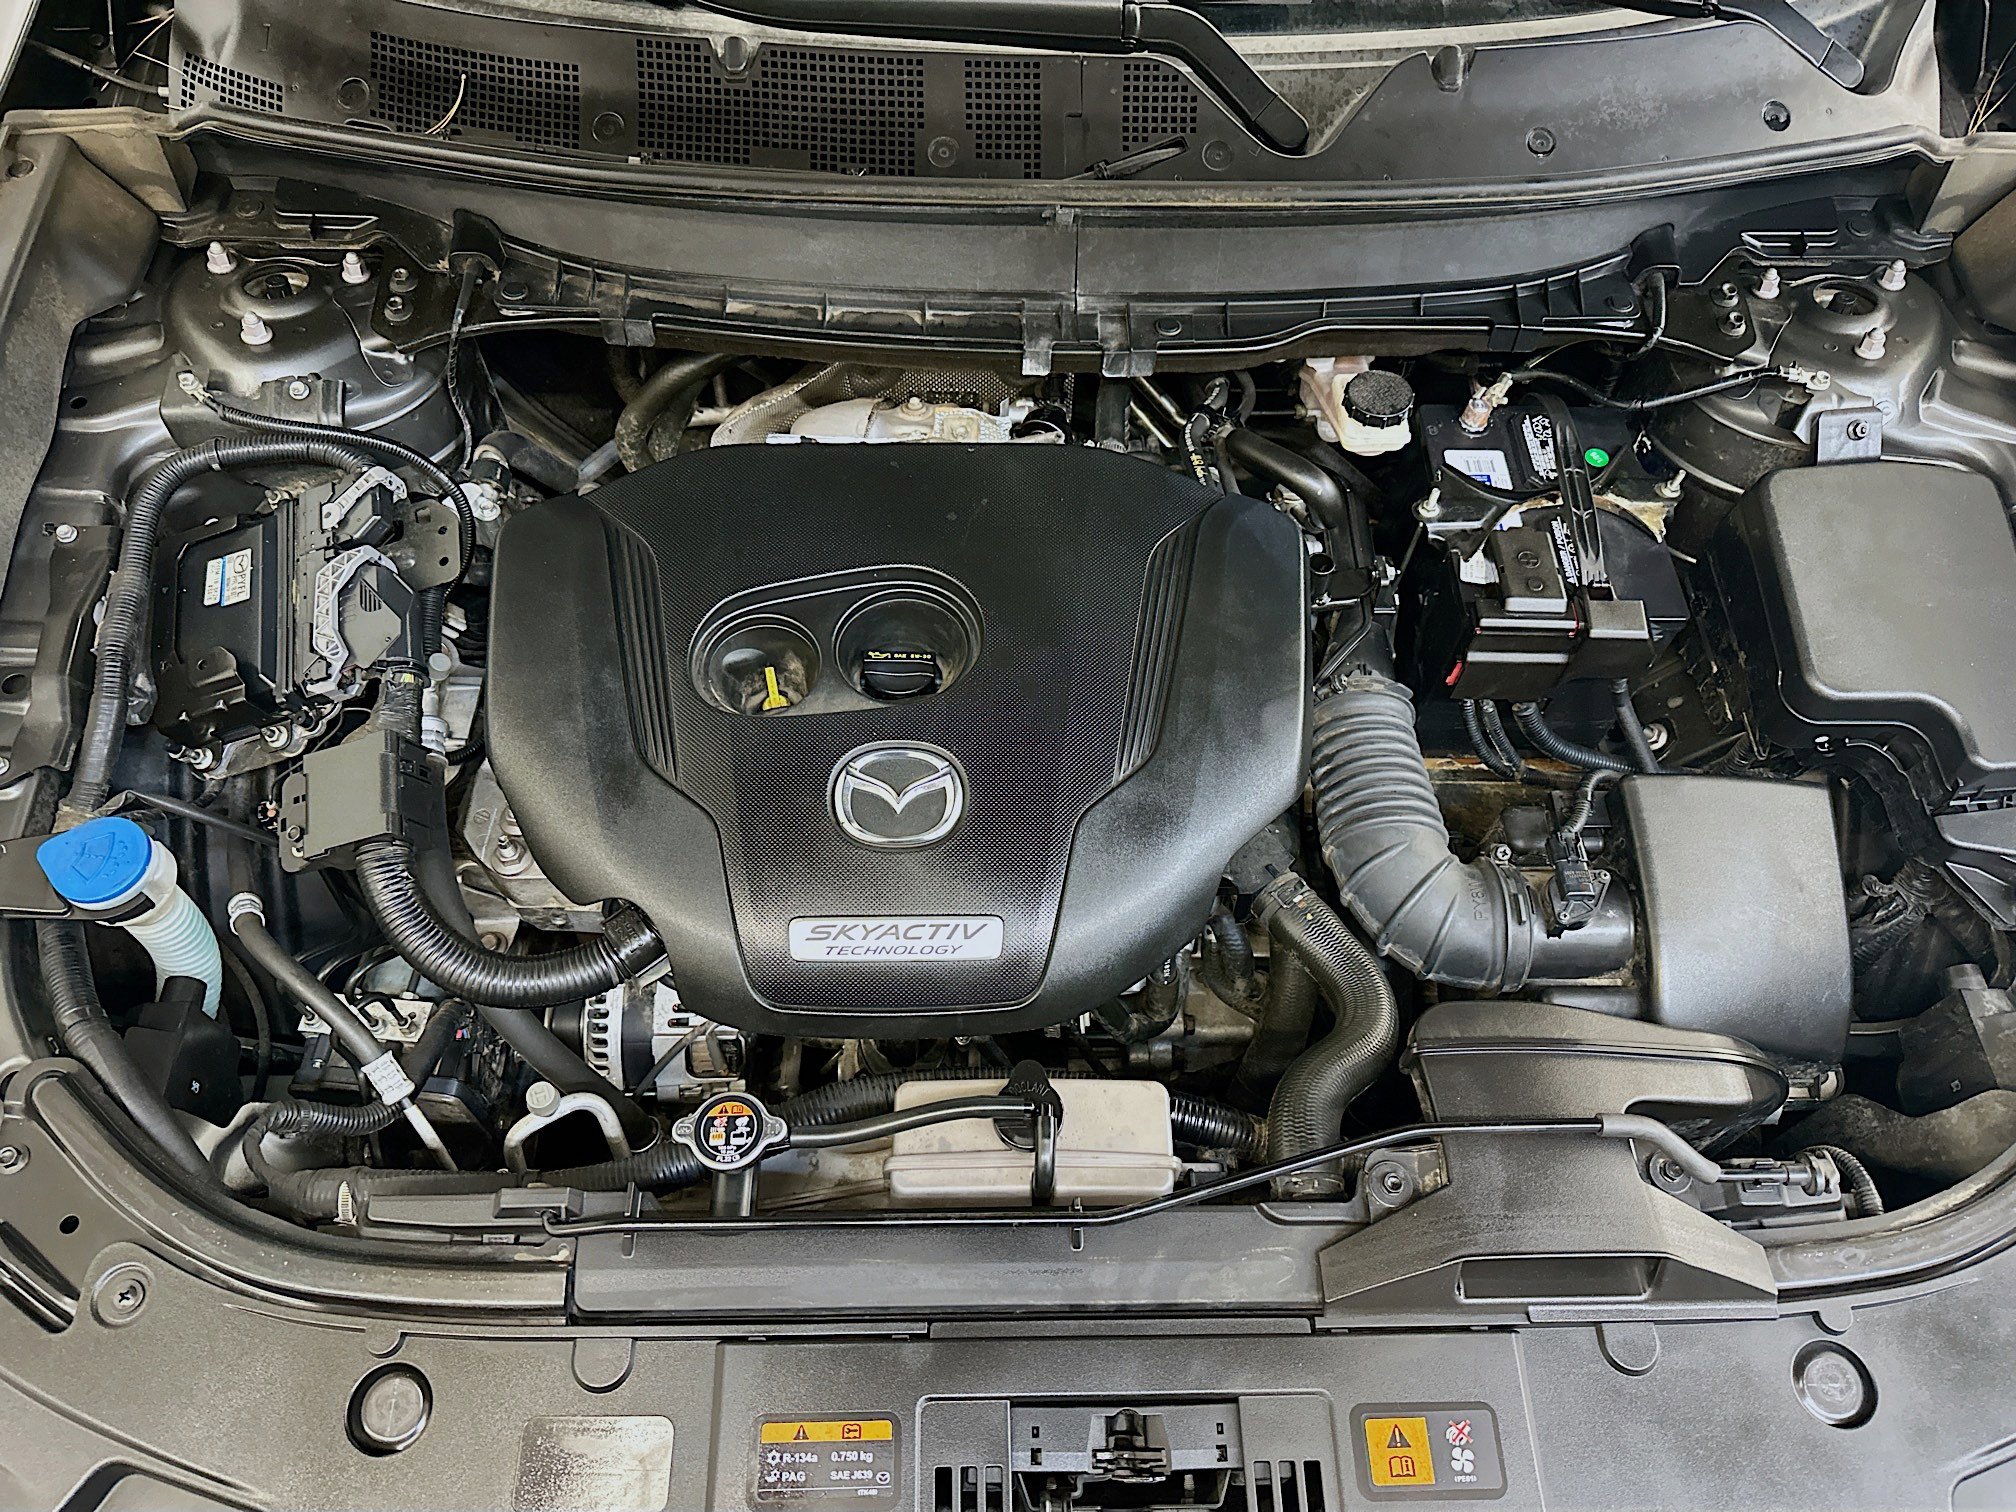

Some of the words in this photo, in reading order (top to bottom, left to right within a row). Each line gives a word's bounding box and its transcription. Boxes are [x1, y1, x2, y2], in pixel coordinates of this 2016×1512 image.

[805, 923, 988, 941] SKYACTIV
[825, 945, 963, 956] TECHNOLOGY
[782, 1453, 818, 1463] R-134a
[830, 1451, 858, 1462] 0.750
[859, 1451, 874, 1463] kg
[782, 1471, 806, 1482] PAG
[830, 1471, 851, 1480] SAE
